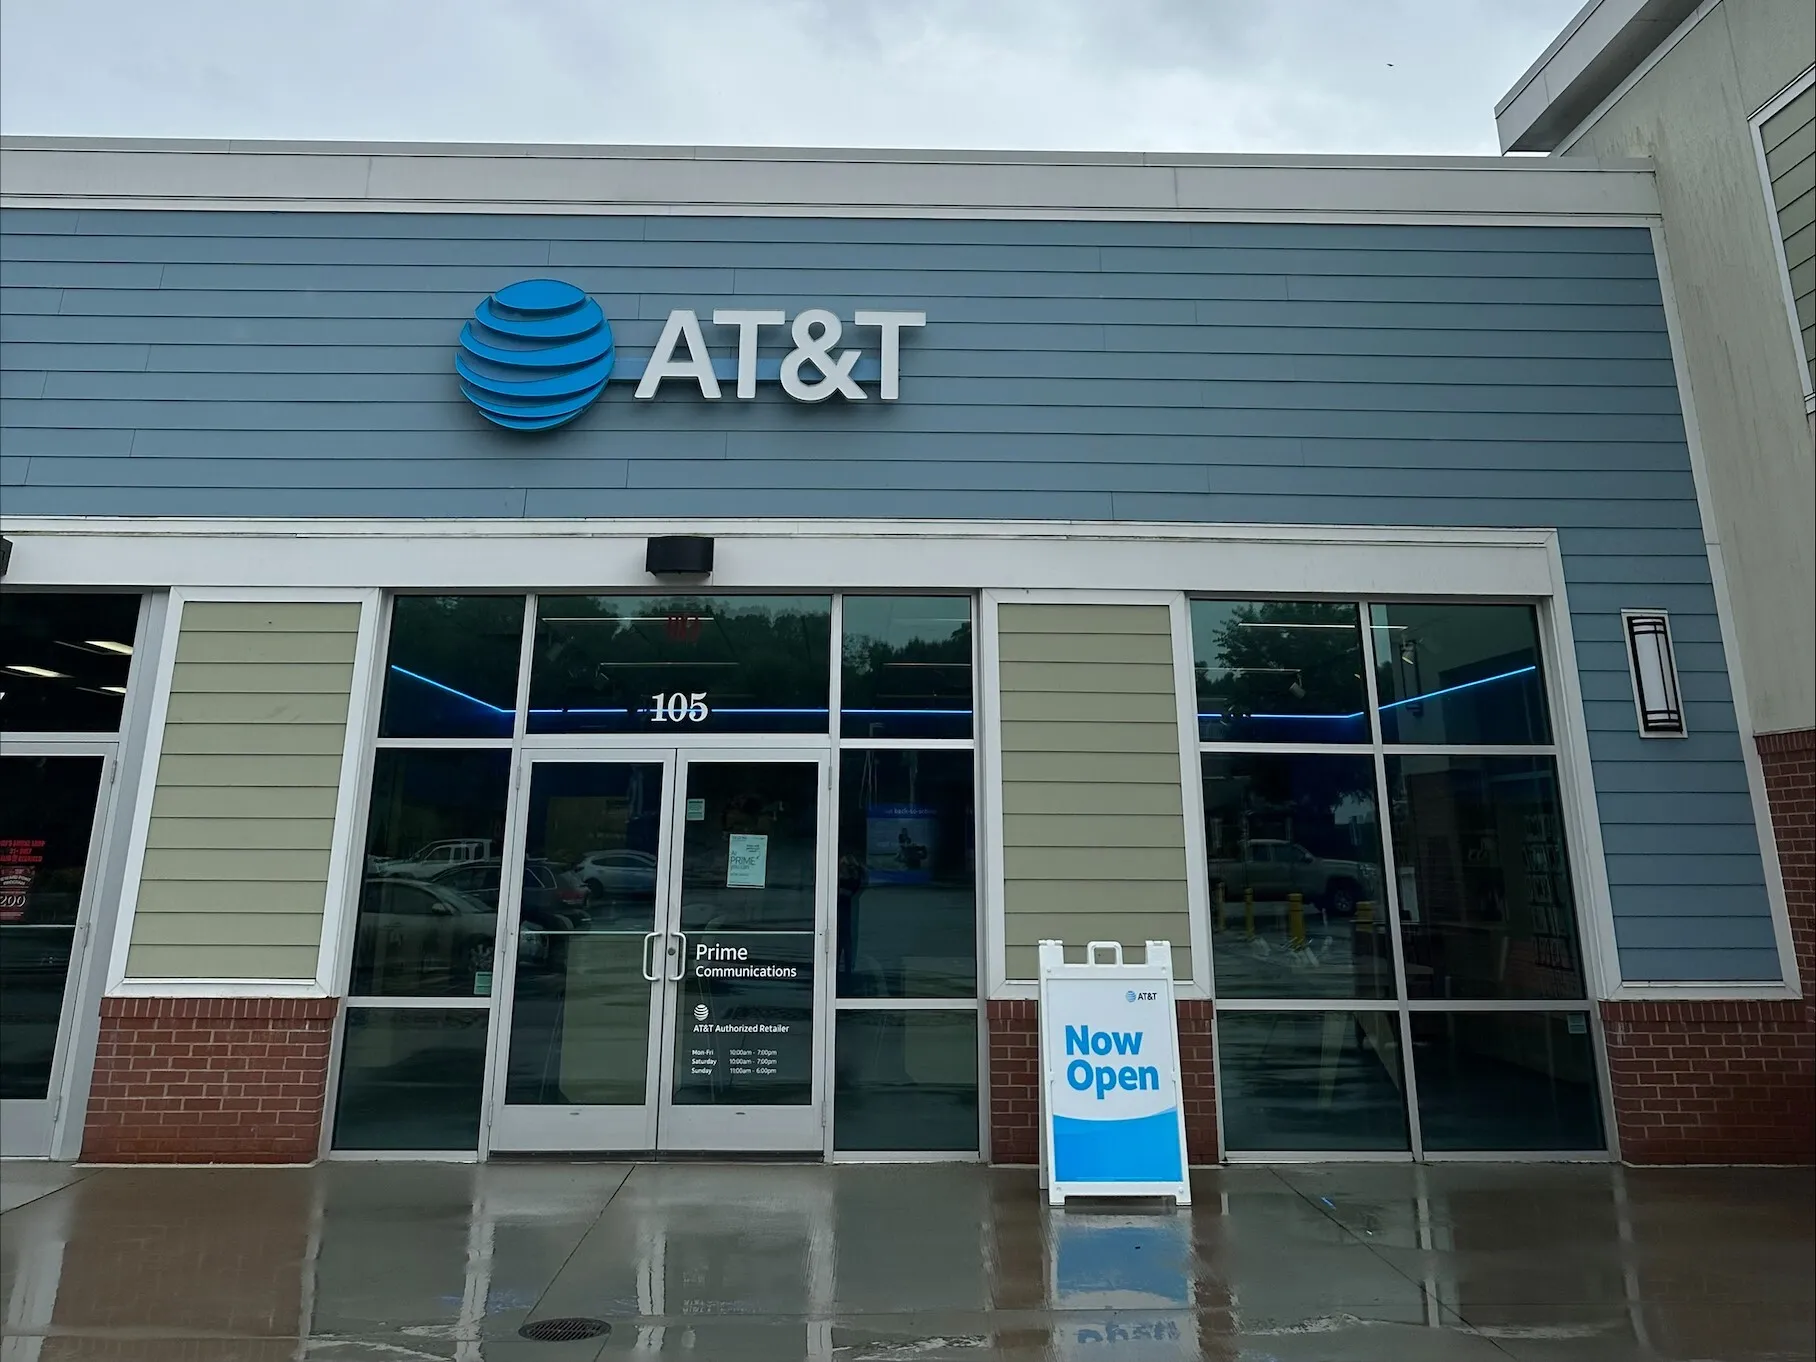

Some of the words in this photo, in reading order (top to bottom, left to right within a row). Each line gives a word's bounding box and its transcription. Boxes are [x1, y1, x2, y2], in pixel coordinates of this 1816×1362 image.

[633, 308, 927, 401] AT&T
[651, 692, 708, 722] 105
[696, 943, 748, 961] Prime
[695, 965, 797, 978] Communications
[1137, 991, 1157, 1001] AT&T
[692, 1024, 714, 1033] AT&T
[714, 1024, 758, 1033] Authorized
[759, 1024, 790, 1033] Retailer
[1065, 1025, 1144, 1056] Now
[757, 1049, 778, 1057] 7:00pm
[691, 1058, 717, 1066] Saturday
[691, 1067, 713, 1075] Sunday
[1067, 1059, 1160, 1100] Open
